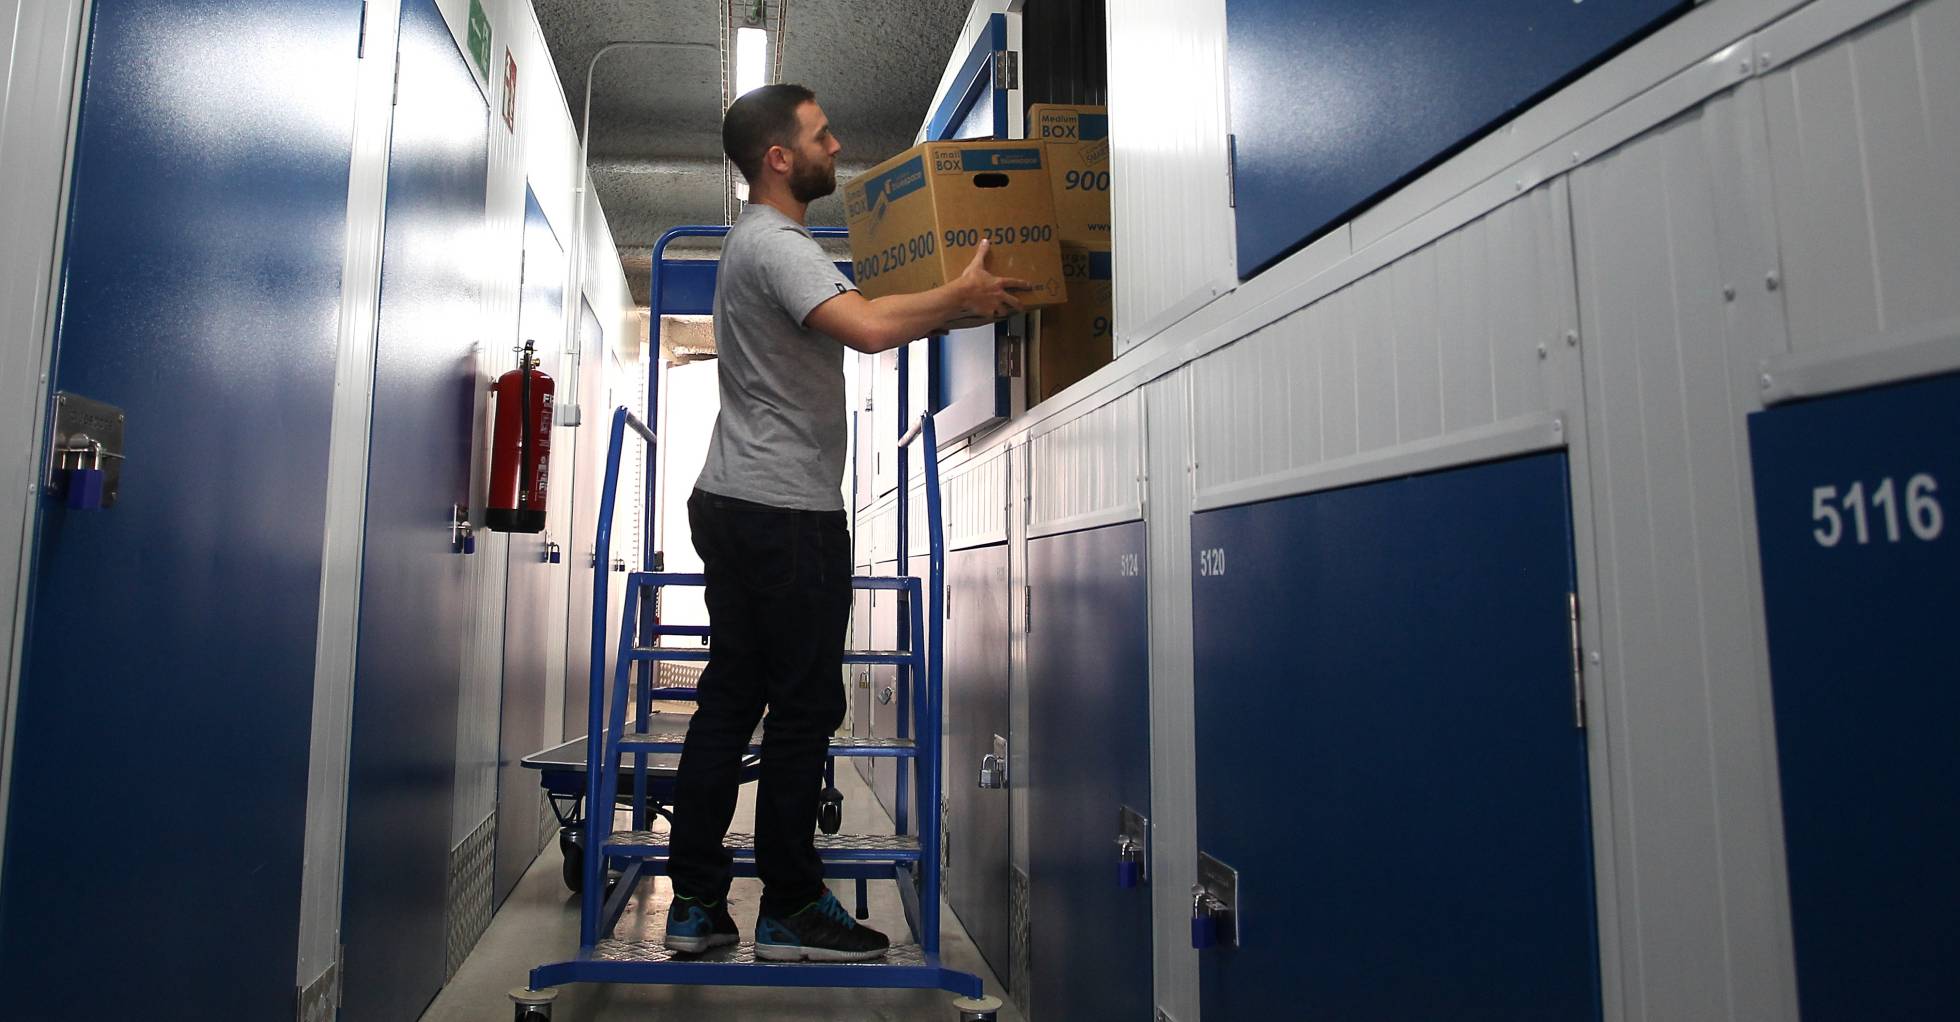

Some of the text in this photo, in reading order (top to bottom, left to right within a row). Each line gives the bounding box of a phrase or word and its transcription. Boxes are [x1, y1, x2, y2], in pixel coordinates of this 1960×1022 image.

[1042, 115, 1077, 124] Medium
[1042, 125, 1077, 138] BOX
[935, 151, 961, 160] Small
[936, 160, 962, 171] BOX
[1065, 170, 1111, 192] 900
[945, 225, 1051, 248] 900 250 900
[857, 231, 935, 283] 900 250 900
[1812, 472, 1944, 548] 5116
[1120, 553, 1138, 577] 5124
[1200, 548, 1226, 577] 5120
